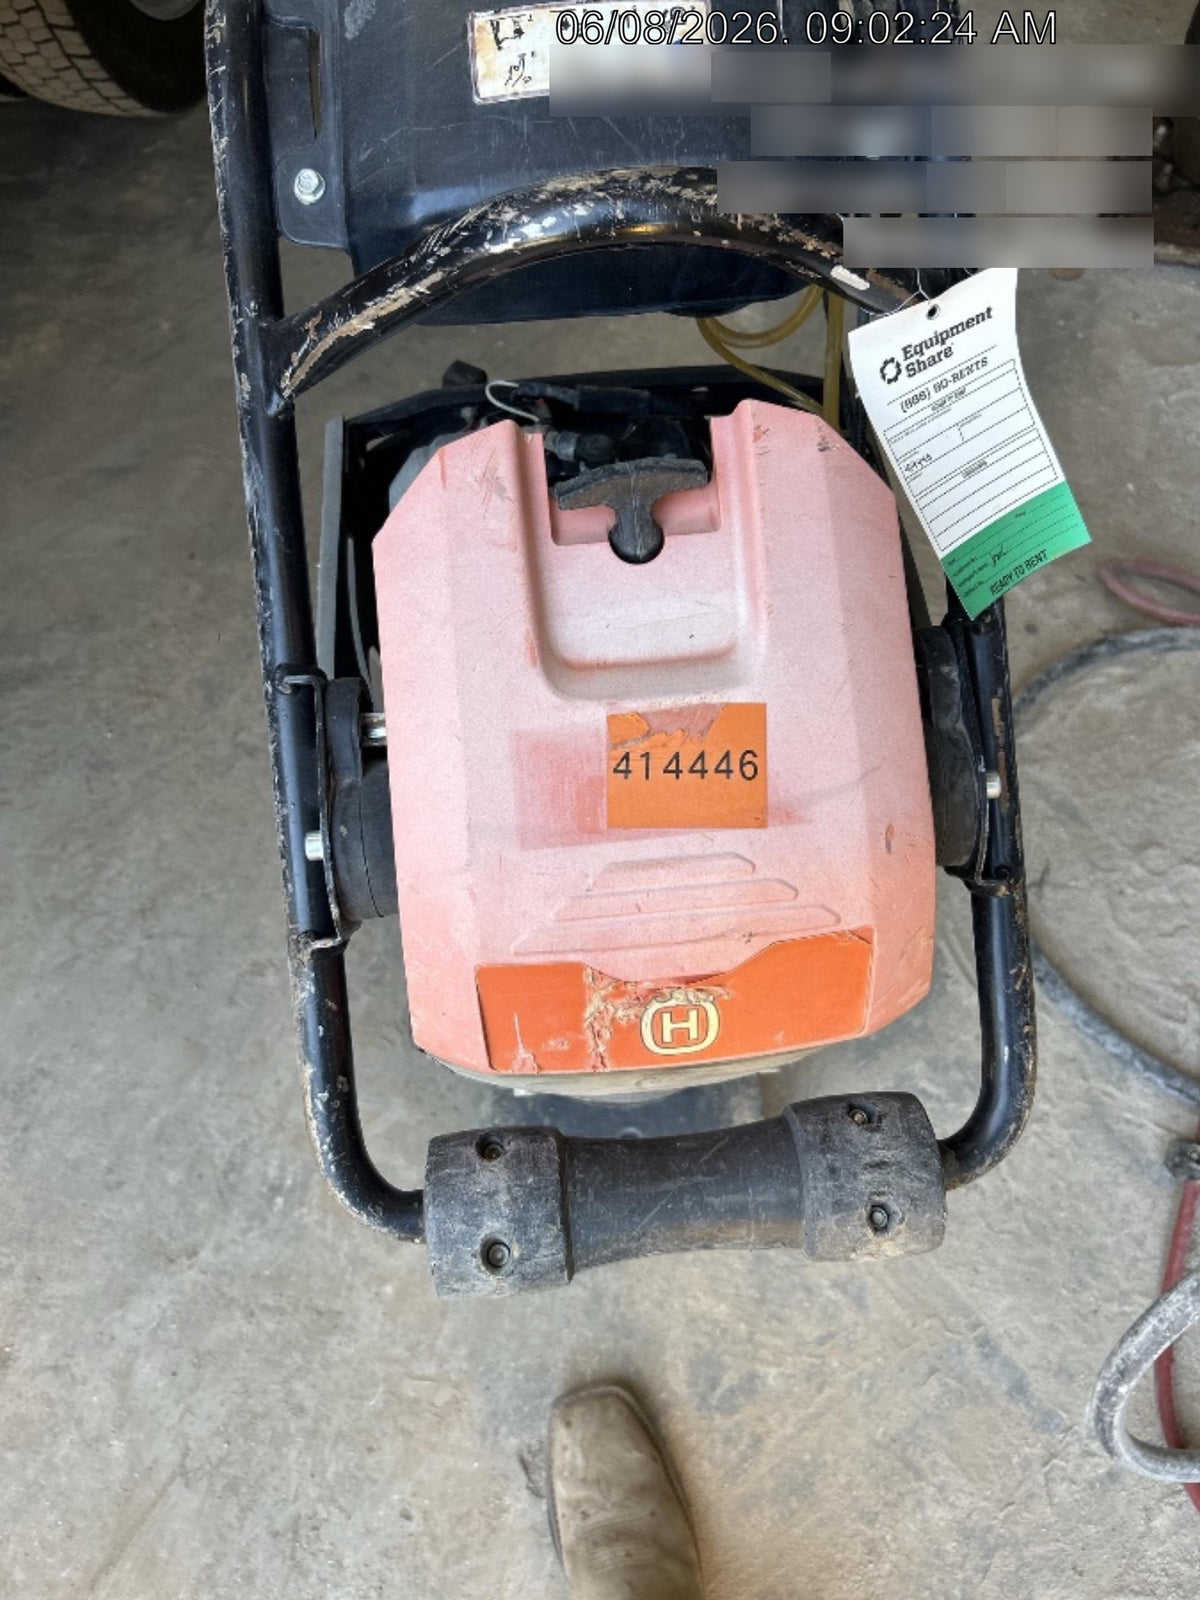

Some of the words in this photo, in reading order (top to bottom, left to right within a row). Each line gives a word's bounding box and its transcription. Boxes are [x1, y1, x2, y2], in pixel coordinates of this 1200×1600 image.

[902, 306, 994, 360] Equipment
[904, 346, 954, 380] Share
[990, 574, 1013, 596] READY
[1012, 565, 1026, 580] TO
[1023, 548, 1049, 572] RENT
[612, 749, 759, 782] 414446
